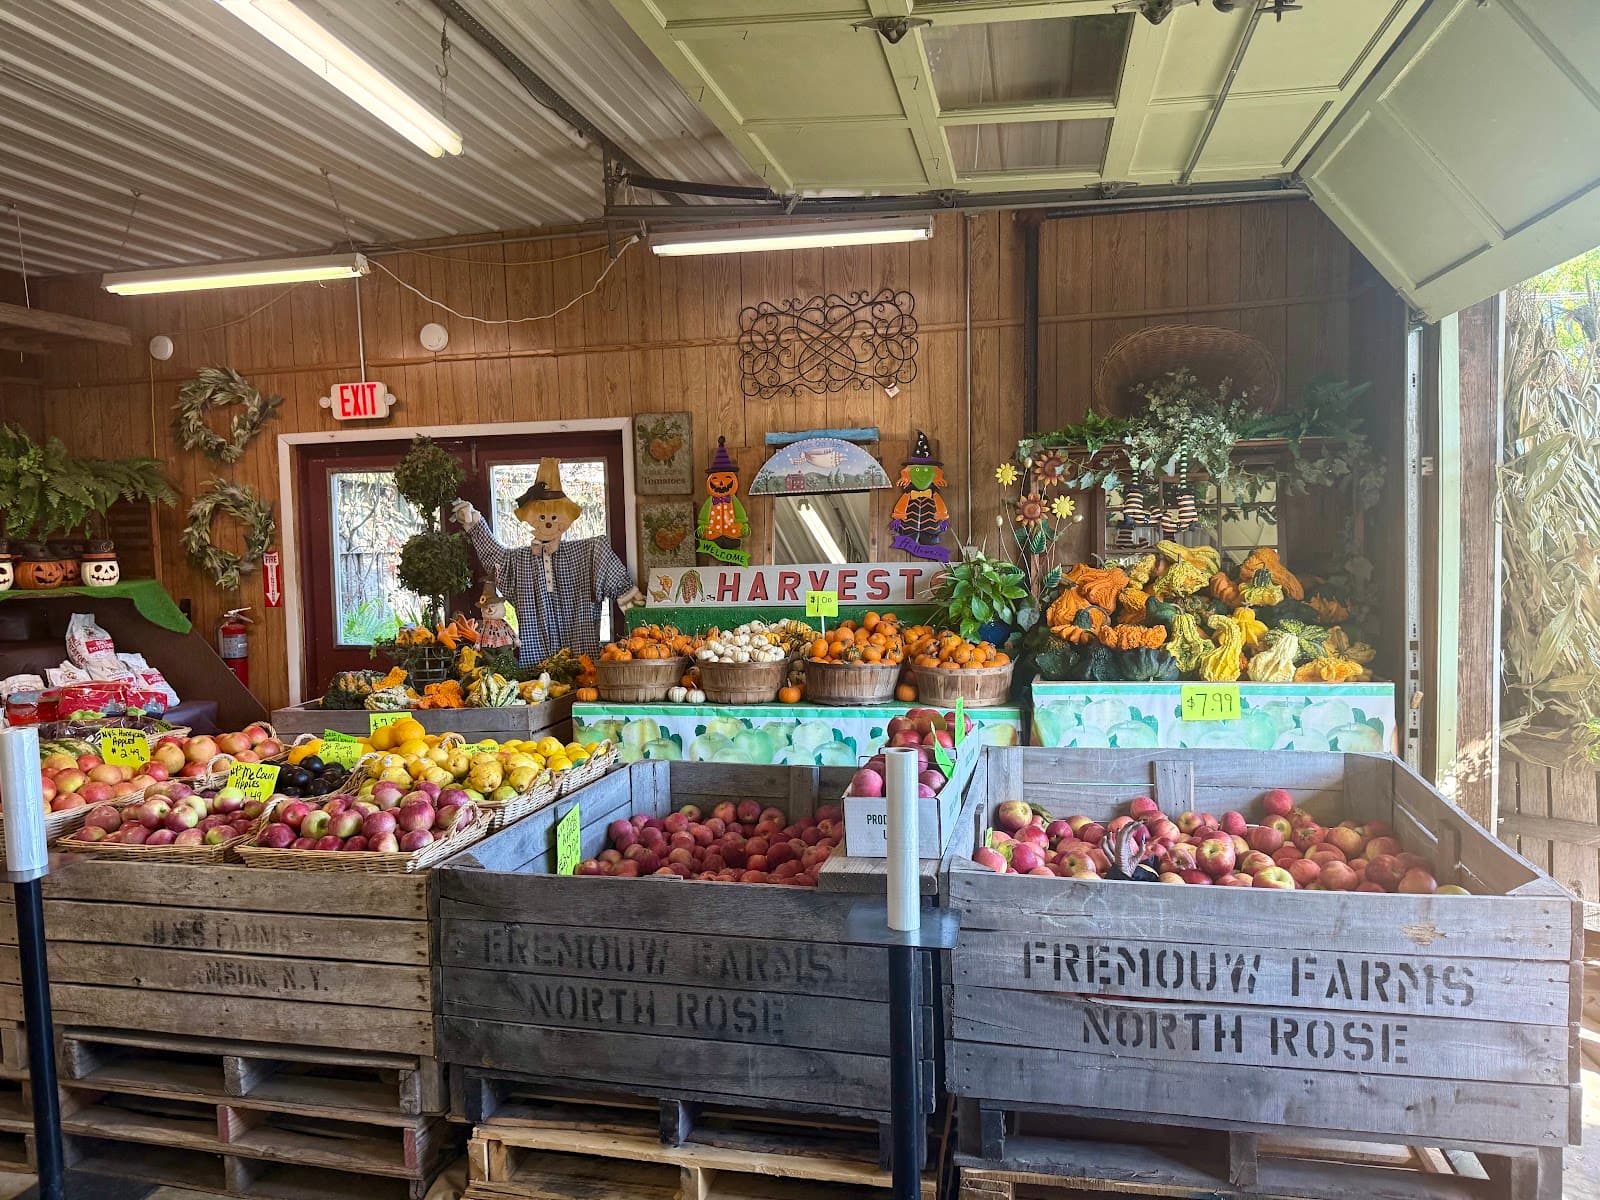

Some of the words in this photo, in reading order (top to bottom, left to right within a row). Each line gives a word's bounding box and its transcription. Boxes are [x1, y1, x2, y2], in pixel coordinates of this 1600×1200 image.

[340, 384, 376, 416] EXIT
[265, 556, 277, 564] FIRE
[703, 543, 745, 562] WELCOME
[715, 569, 923, 602] HARVEST
[1186, 693, 1232, 717] $7.99
[484, 927, 671, 976] FREMOUW
[700, 938, 834, 984] FARMS
[1023, 941, 1262, 994] FREMOUW
[1291, 956, 1475, 1008] FARMS
[528, 981, 655, 1026] NORTH
[676, 992, 785, 1035] ROSE
[1082, 1006, 1243, 1054] NORTH
[1270, 1016, 1408, 1064] ROSE
